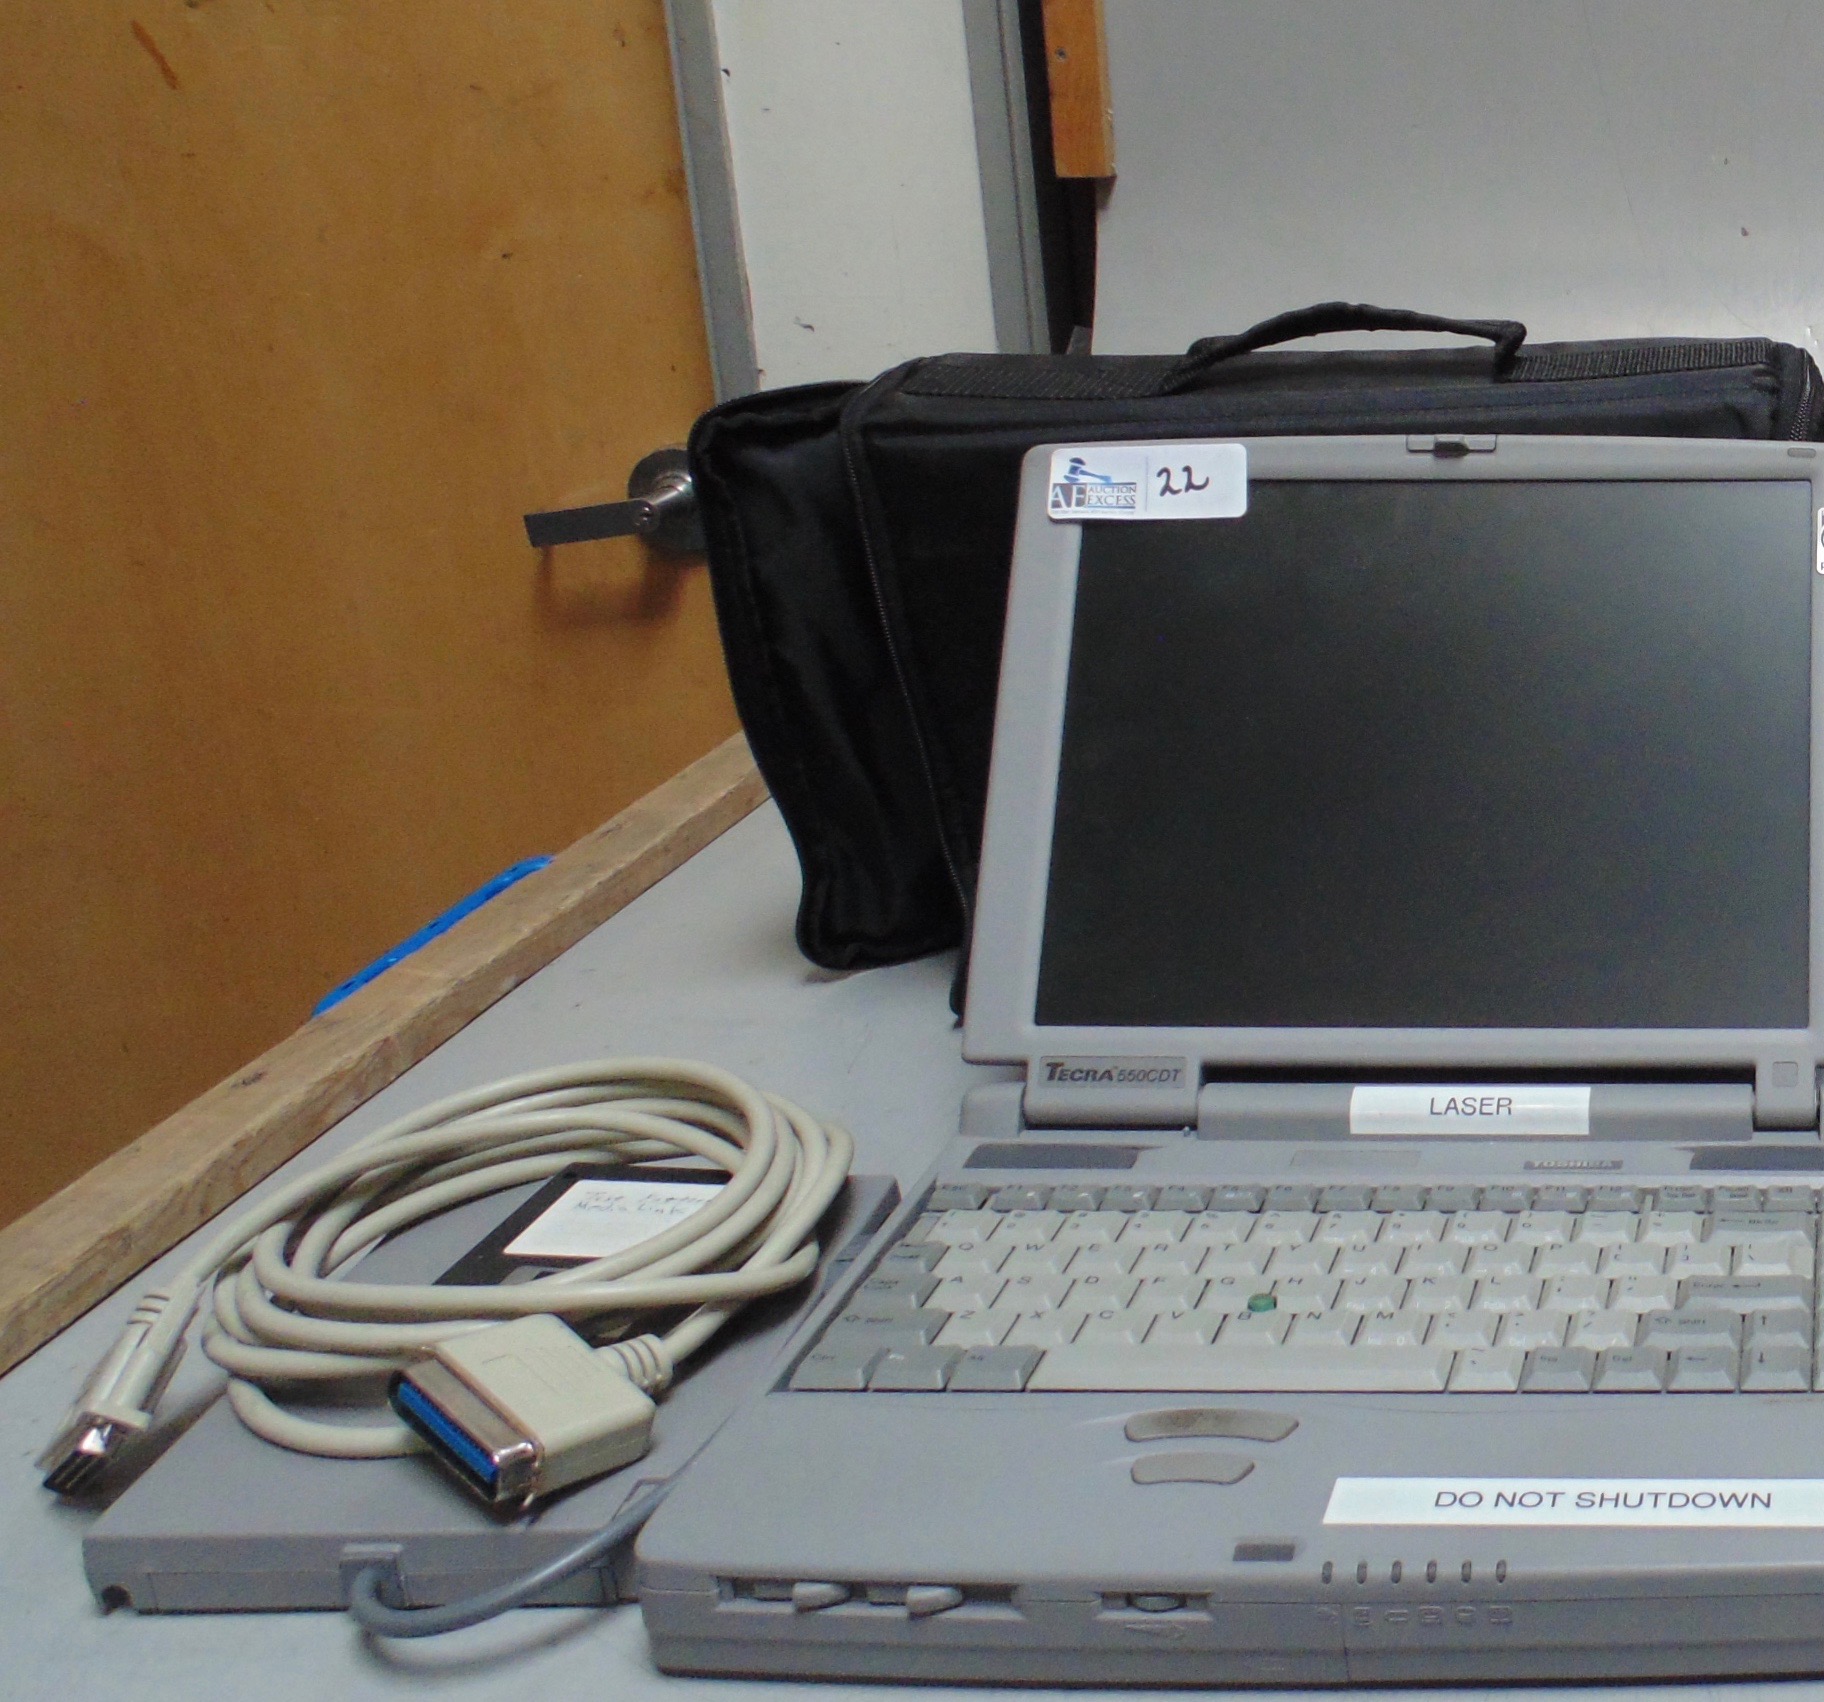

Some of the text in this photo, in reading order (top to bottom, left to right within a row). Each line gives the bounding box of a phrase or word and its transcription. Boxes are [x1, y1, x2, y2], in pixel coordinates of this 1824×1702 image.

[1088, 485, 1137, 495] AUCTION
[1156, 465, 1210, 497] 22
[1087, 494, 1136, 506] EXCESS
[1045, 1062, 1114, 1082] TECRA
[1428, 1096, 1513, 1116] LASER
[1434, 1490, 1772, 1510] DO NOT SHUTDOWN
